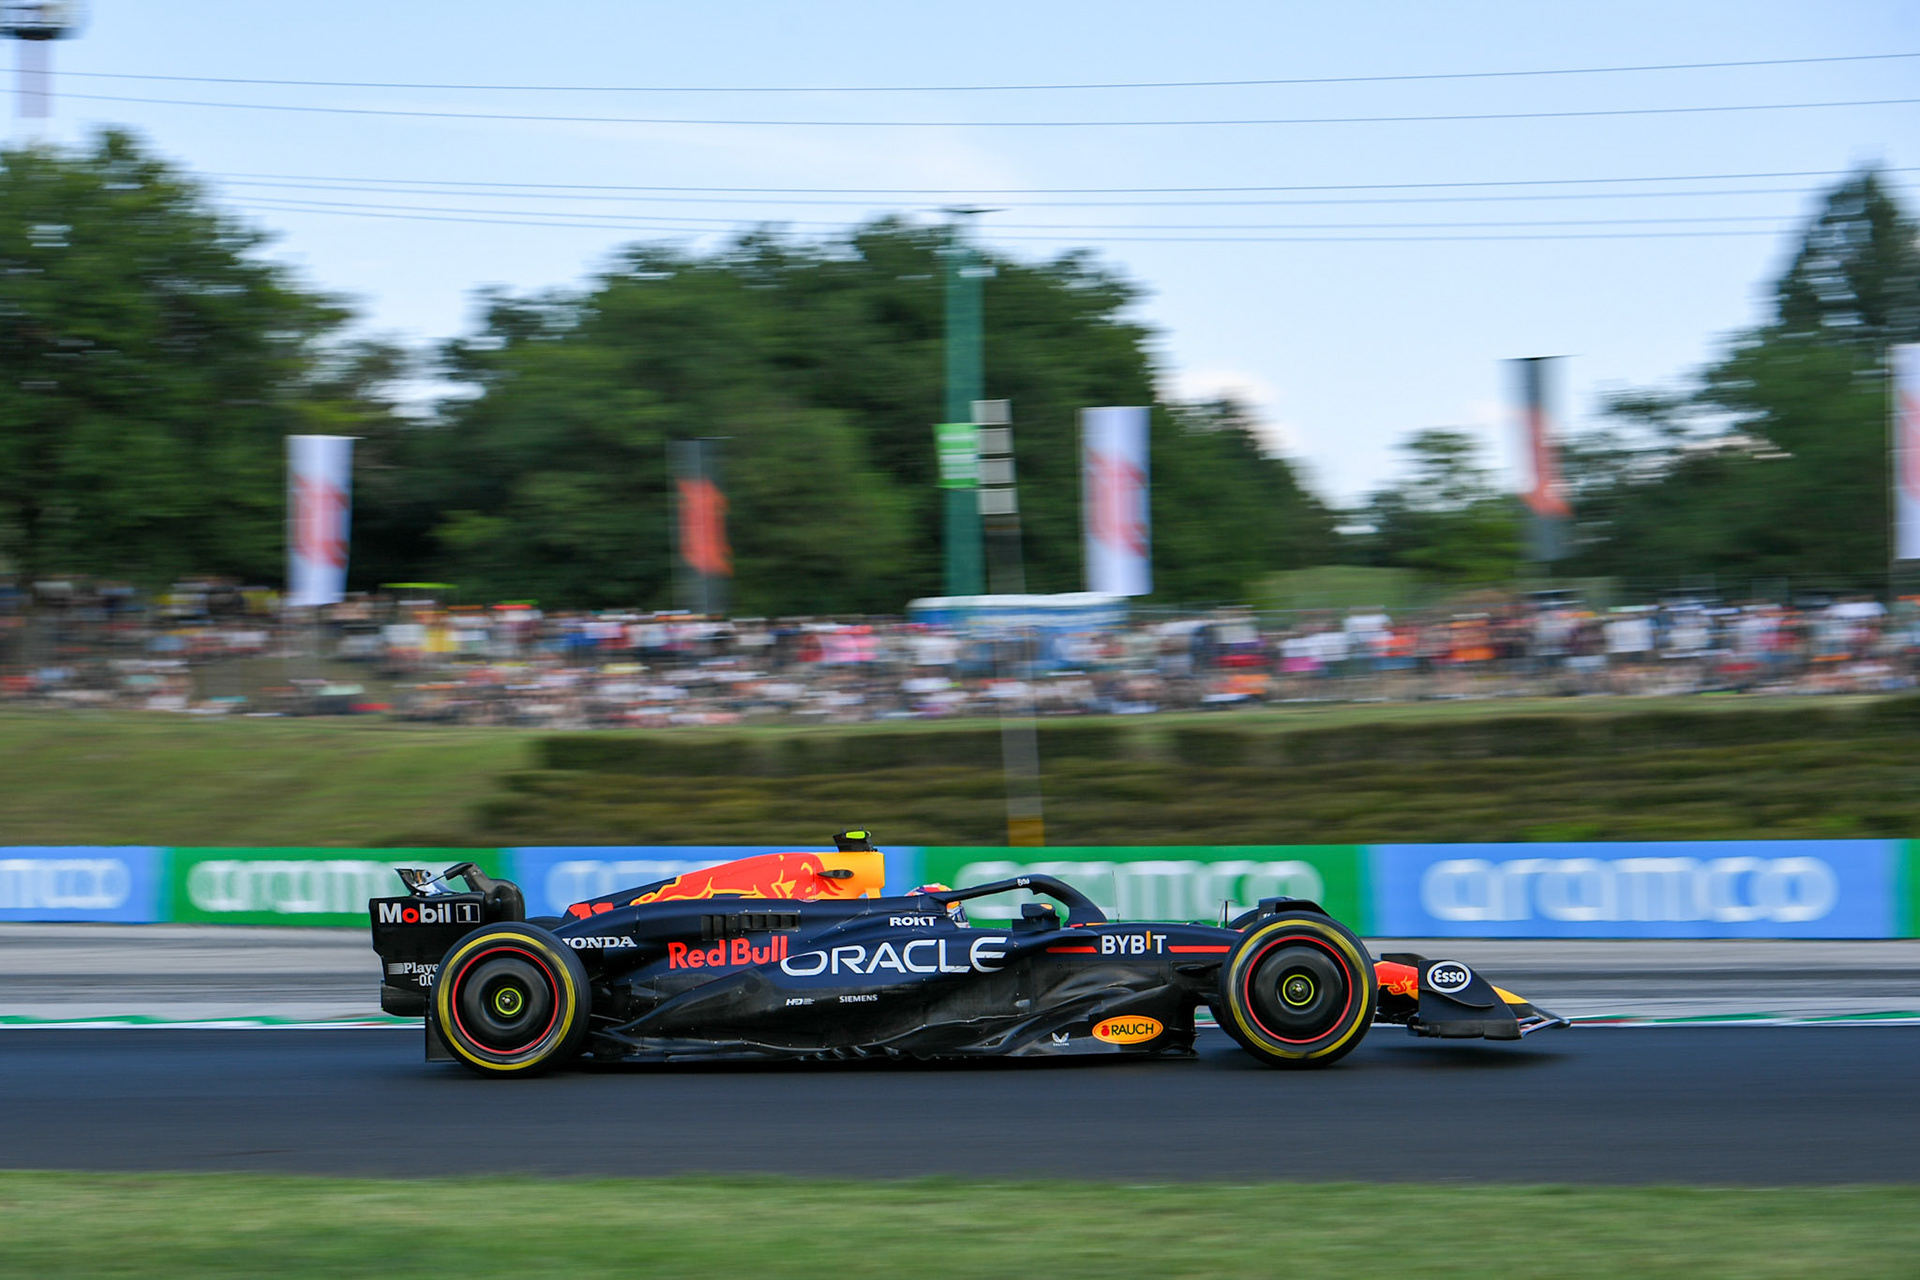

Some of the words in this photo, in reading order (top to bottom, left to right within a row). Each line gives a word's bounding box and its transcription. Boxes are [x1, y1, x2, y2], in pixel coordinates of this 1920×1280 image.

[378, 903, 451, 924] Mobil
[889, 916, 937, 927] ROKT
[562, 936, 638, 949] ONDA
[1101, 930, 1167, 954] BYBIT
[667, 939, 726, 970] Red
[730, 935, 788, 966] Bull
[780, 936, 1008, 977] ORACLE
[839, 994, 878, 1004] SIEMENS
[1111, 1023, 1155, 1036] RAUCH
